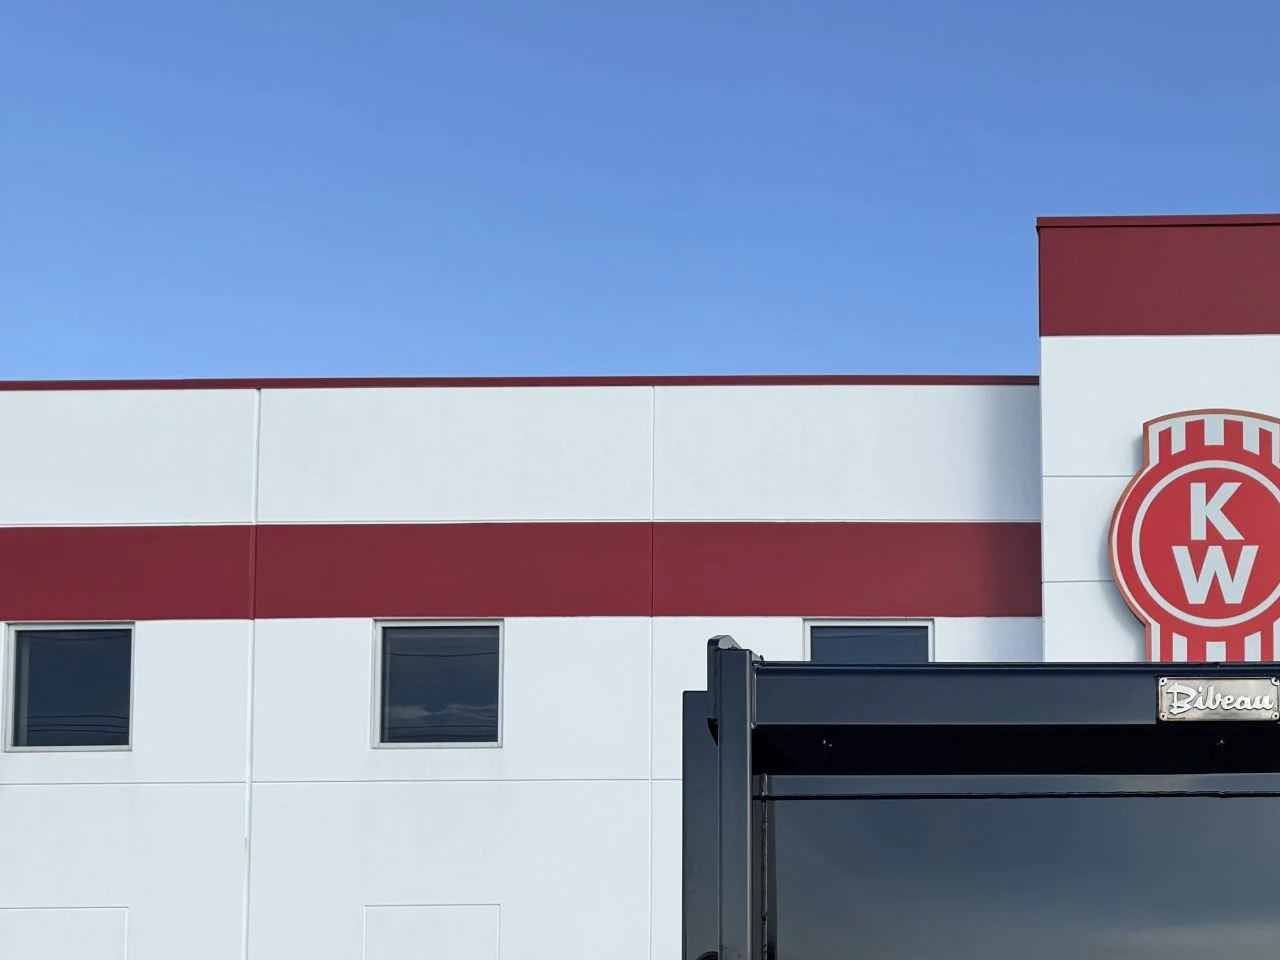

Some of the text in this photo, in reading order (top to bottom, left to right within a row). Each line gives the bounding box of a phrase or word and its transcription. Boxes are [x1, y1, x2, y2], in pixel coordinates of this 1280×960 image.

[1190, 482, 1245, 541] K
[1171, 545, 1259, 605] W
[1166, 682, 1275, 715] Bibeau
